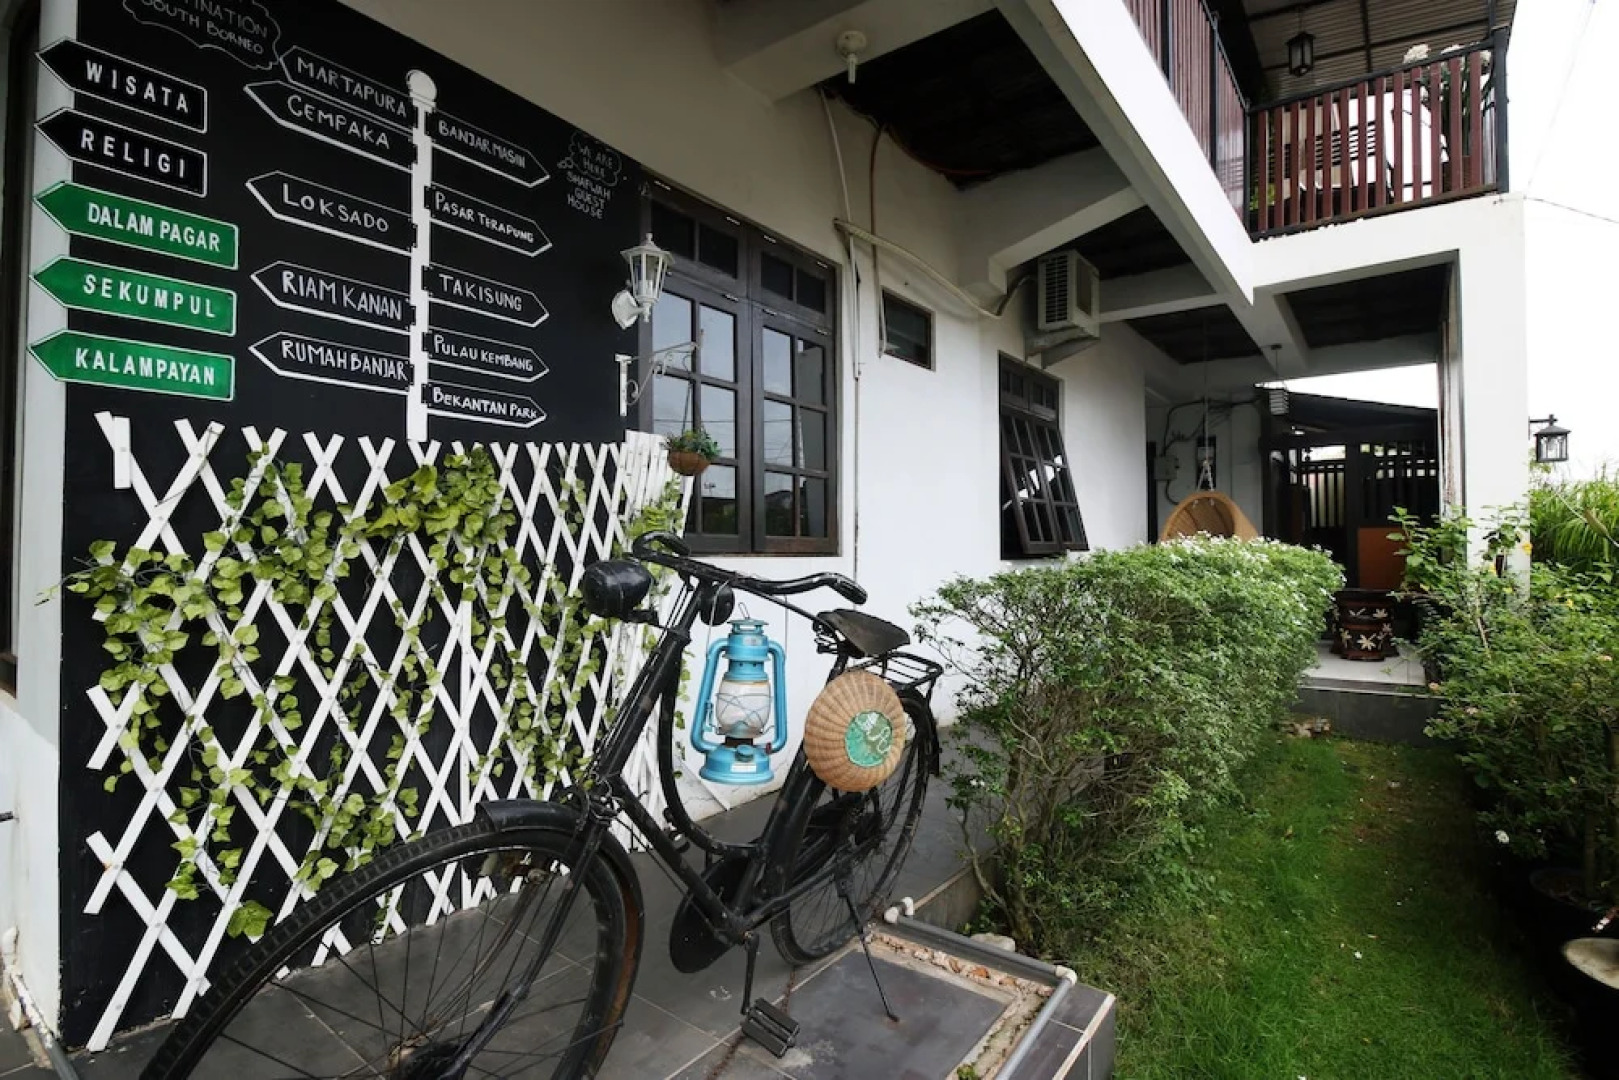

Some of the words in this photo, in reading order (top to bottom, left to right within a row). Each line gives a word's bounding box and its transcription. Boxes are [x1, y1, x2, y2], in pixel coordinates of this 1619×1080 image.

[206, 21, 263, 54] BORNEO
[86, 60, 189, 113] WISATA
[297, 56, 407, 118] MARTAPURA
[287, 94, 390, 149] CEMPAKA
[81, 128, 185, 178] RELIGI
[88, 203, 153, 236] DALAM
[160, 220, 220, 252] PAGAR
[282, 183, 389, 232] LOKSADO
[435, 191, 475, 222] PASAR
[478, 212, 534, 243] TERAPUNG
[567, 194, 603, 219] HOUSE
[83, 273, 216, 318] SEKUMPUL
[282, 270, 336, 304] RIAM
[343, 284, 402, 321] KANAN
[439, 273, 522, 312] TAKISUNG
[75, 347, 215, 386] KALAMPAYAN
[281, 339, 348, 370] RUMAH
[350, 353, 408, 382] BANJAR
[433, 334, 478, 360] PULAU
[481, 351, 533, 372] KEMBANG
[433, 386, 507, 416] BEKANTAN
[510, 403, 537, 420] PARK
